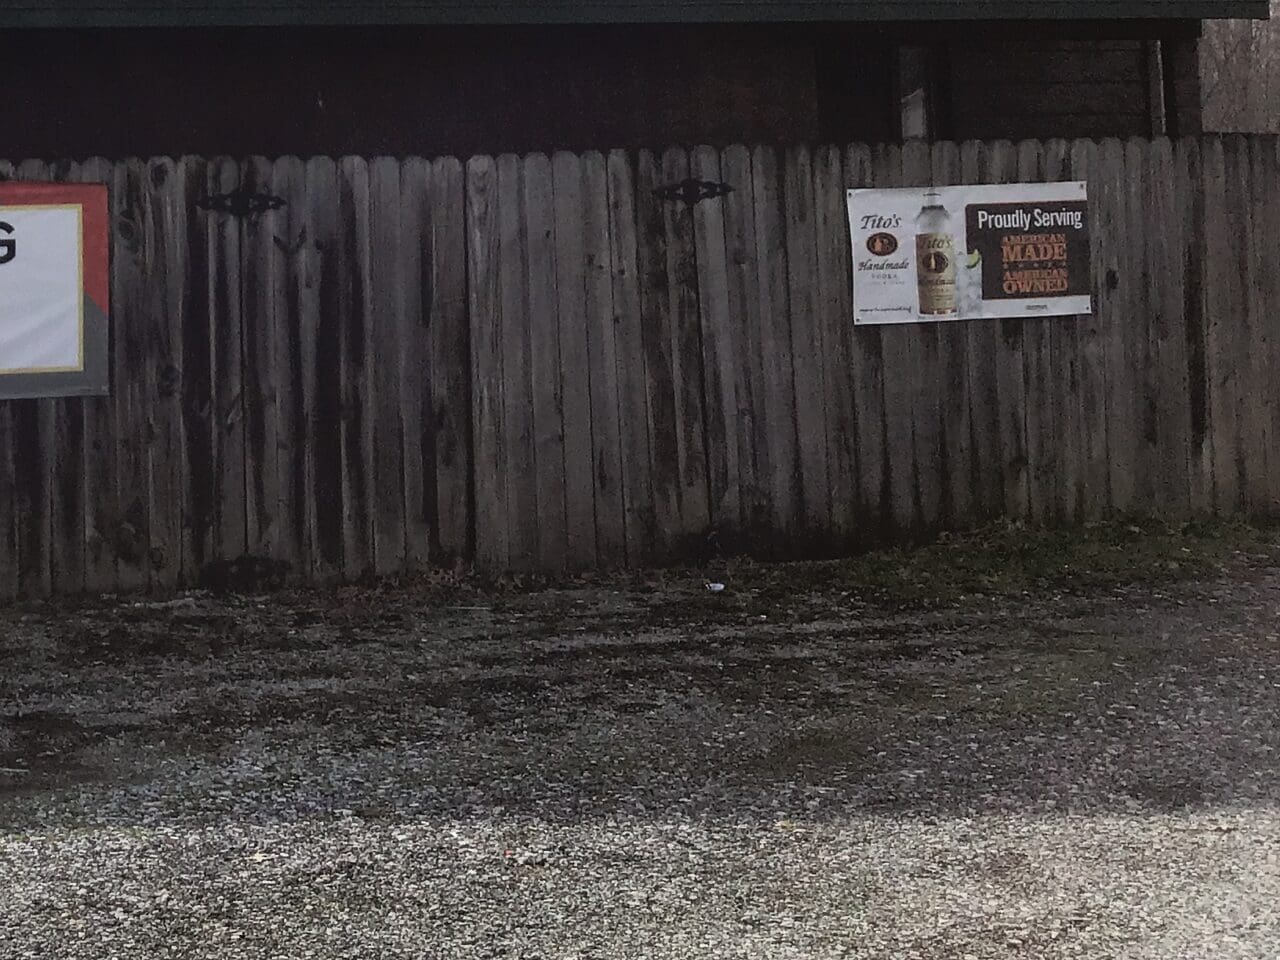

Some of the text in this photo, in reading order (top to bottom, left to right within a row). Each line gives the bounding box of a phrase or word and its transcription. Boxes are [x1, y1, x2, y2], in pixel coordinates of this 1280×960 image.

[860, 213, 902, 230] Tito's
[978, 207, 1083, 231] Proudly Serving
[1001, 243, 1067, 262] MADE
[858, 258, 910, 271] Handmade
[1003, 279, 1069, 294] OWNED
